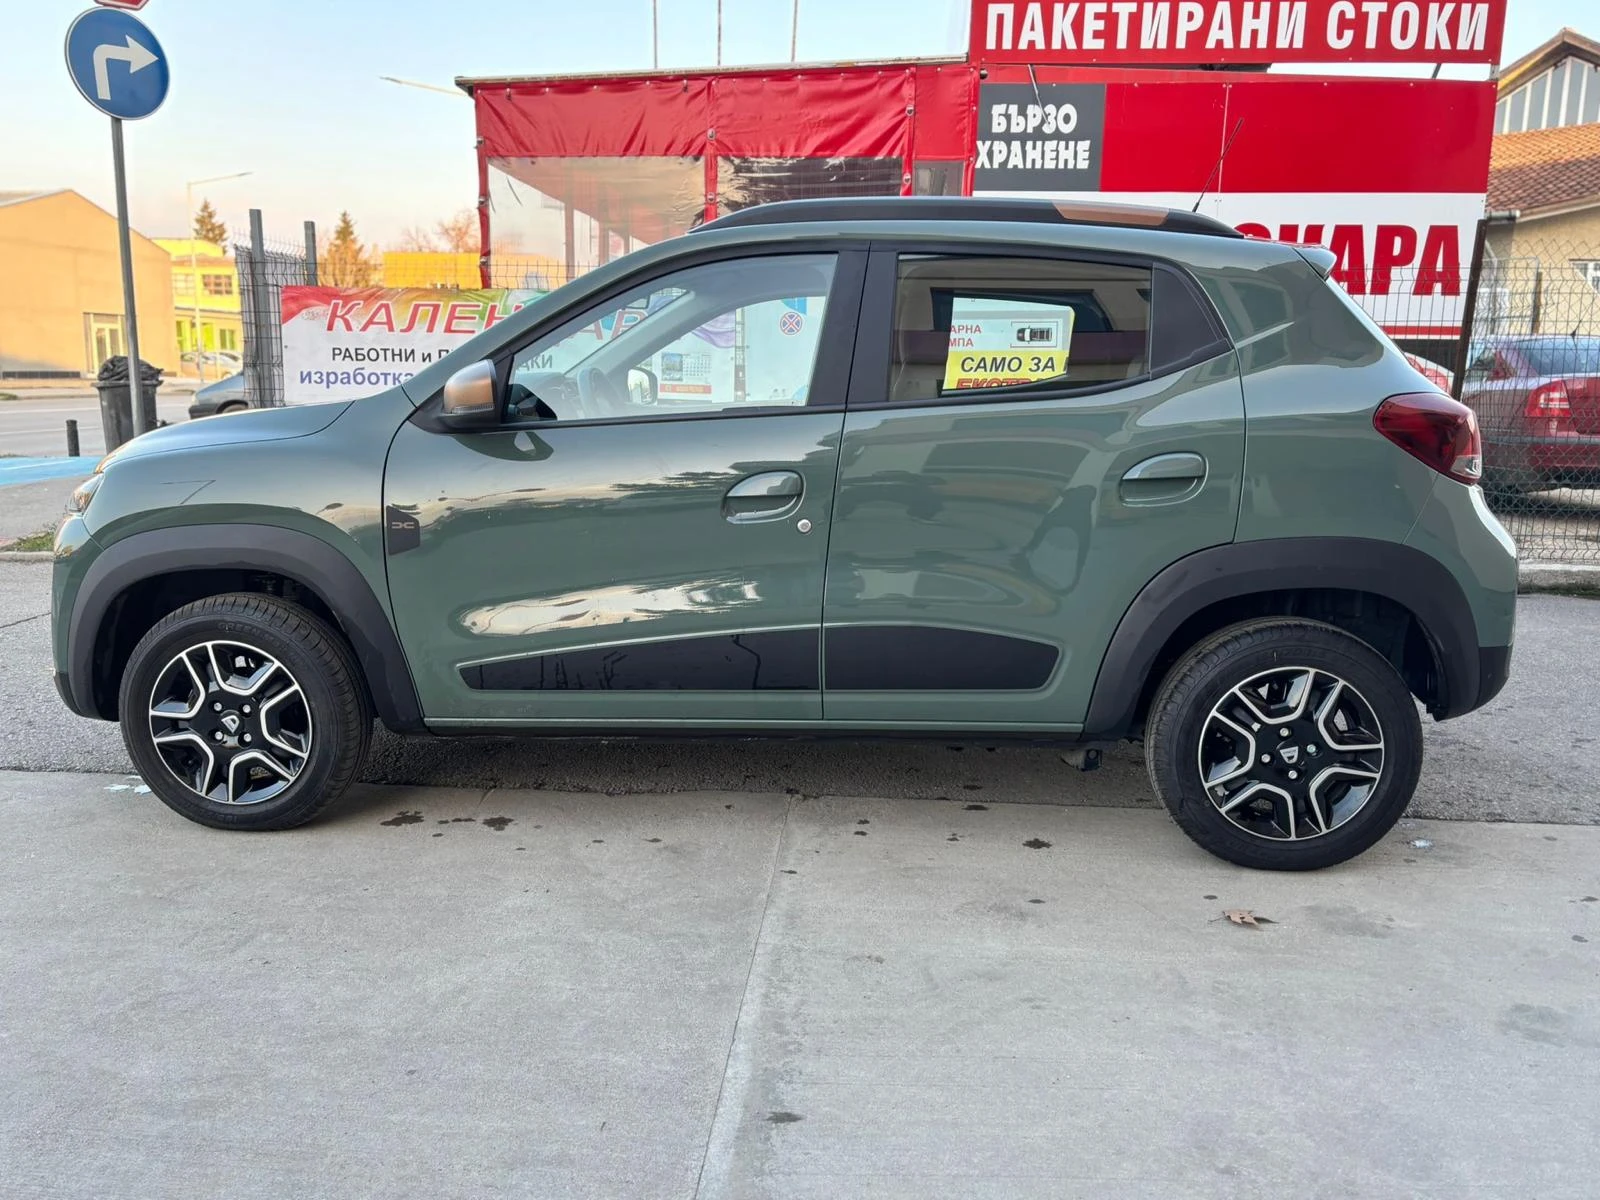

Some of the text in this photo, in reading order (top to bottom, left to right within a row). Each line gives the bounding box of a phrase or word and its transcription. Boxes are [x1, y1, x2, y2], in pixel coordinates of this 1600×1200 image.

[985, 0, 1489, 50] ПАКЕТИРАНИ СТОКИ
[991, 103, 1078, 134] БЪРЗО
[975, 140, 1091, 169] ХРАНЕНЕ
[1234, 222, 1461, 296] АРА
[332, 347, 416, 362] РАБОТНИ
[421, 352, 432, 363] и
[961, 356, 1023, 372] САМО
[1028, 356, 1056, 372] ЗА
